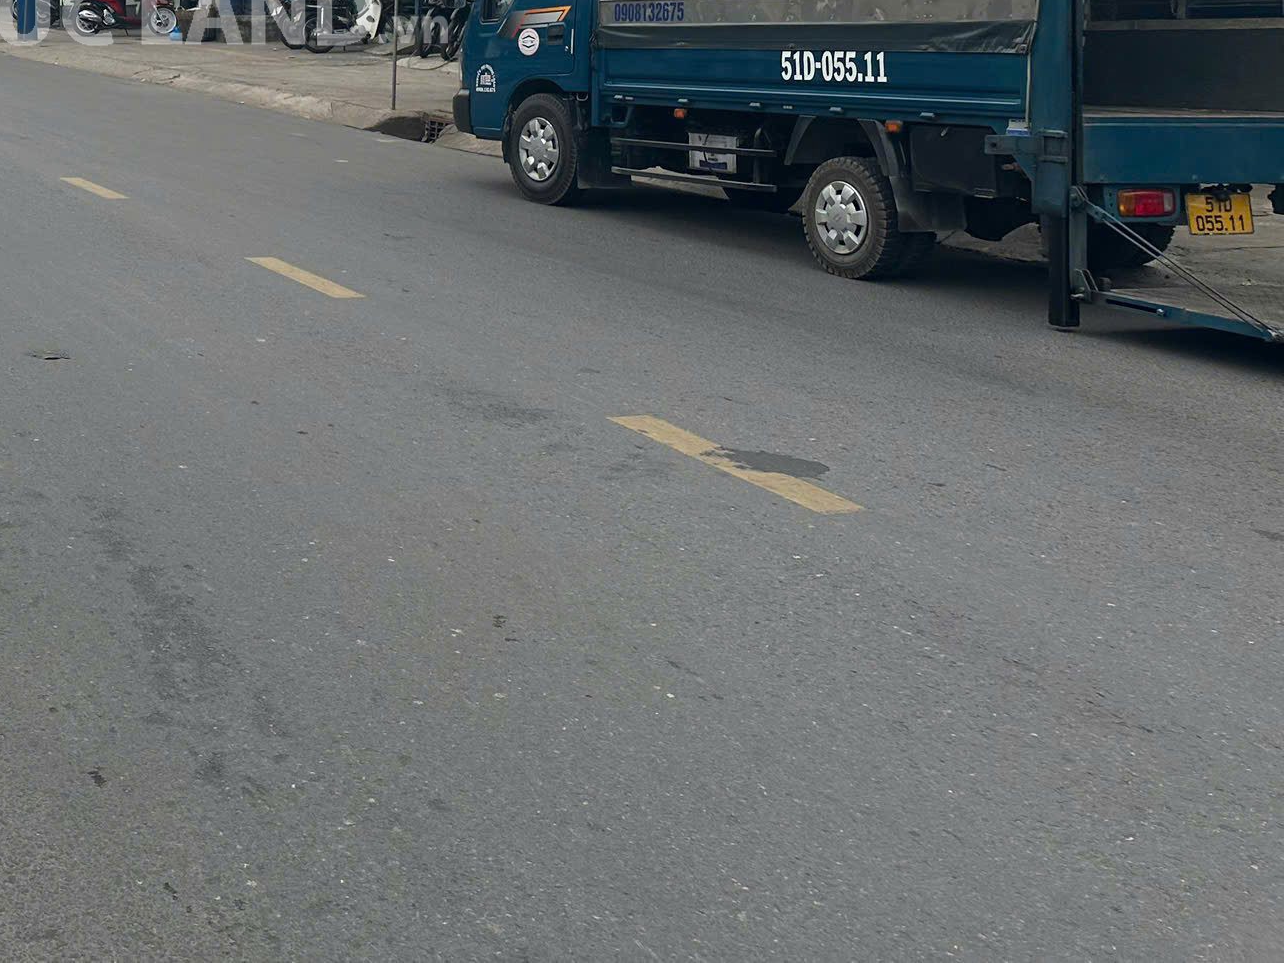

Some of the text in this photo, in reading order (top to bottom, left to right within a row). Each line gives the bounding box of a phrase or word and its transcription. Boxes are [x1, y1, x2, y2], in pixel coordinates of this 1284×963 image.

[614, 2, 685, 22] 0908132675
[781, 50, 888, 83] 51D-055.11
[1205, 197, 1233, 213] 51D
[1196, 214, 1245, 232] 055.11
